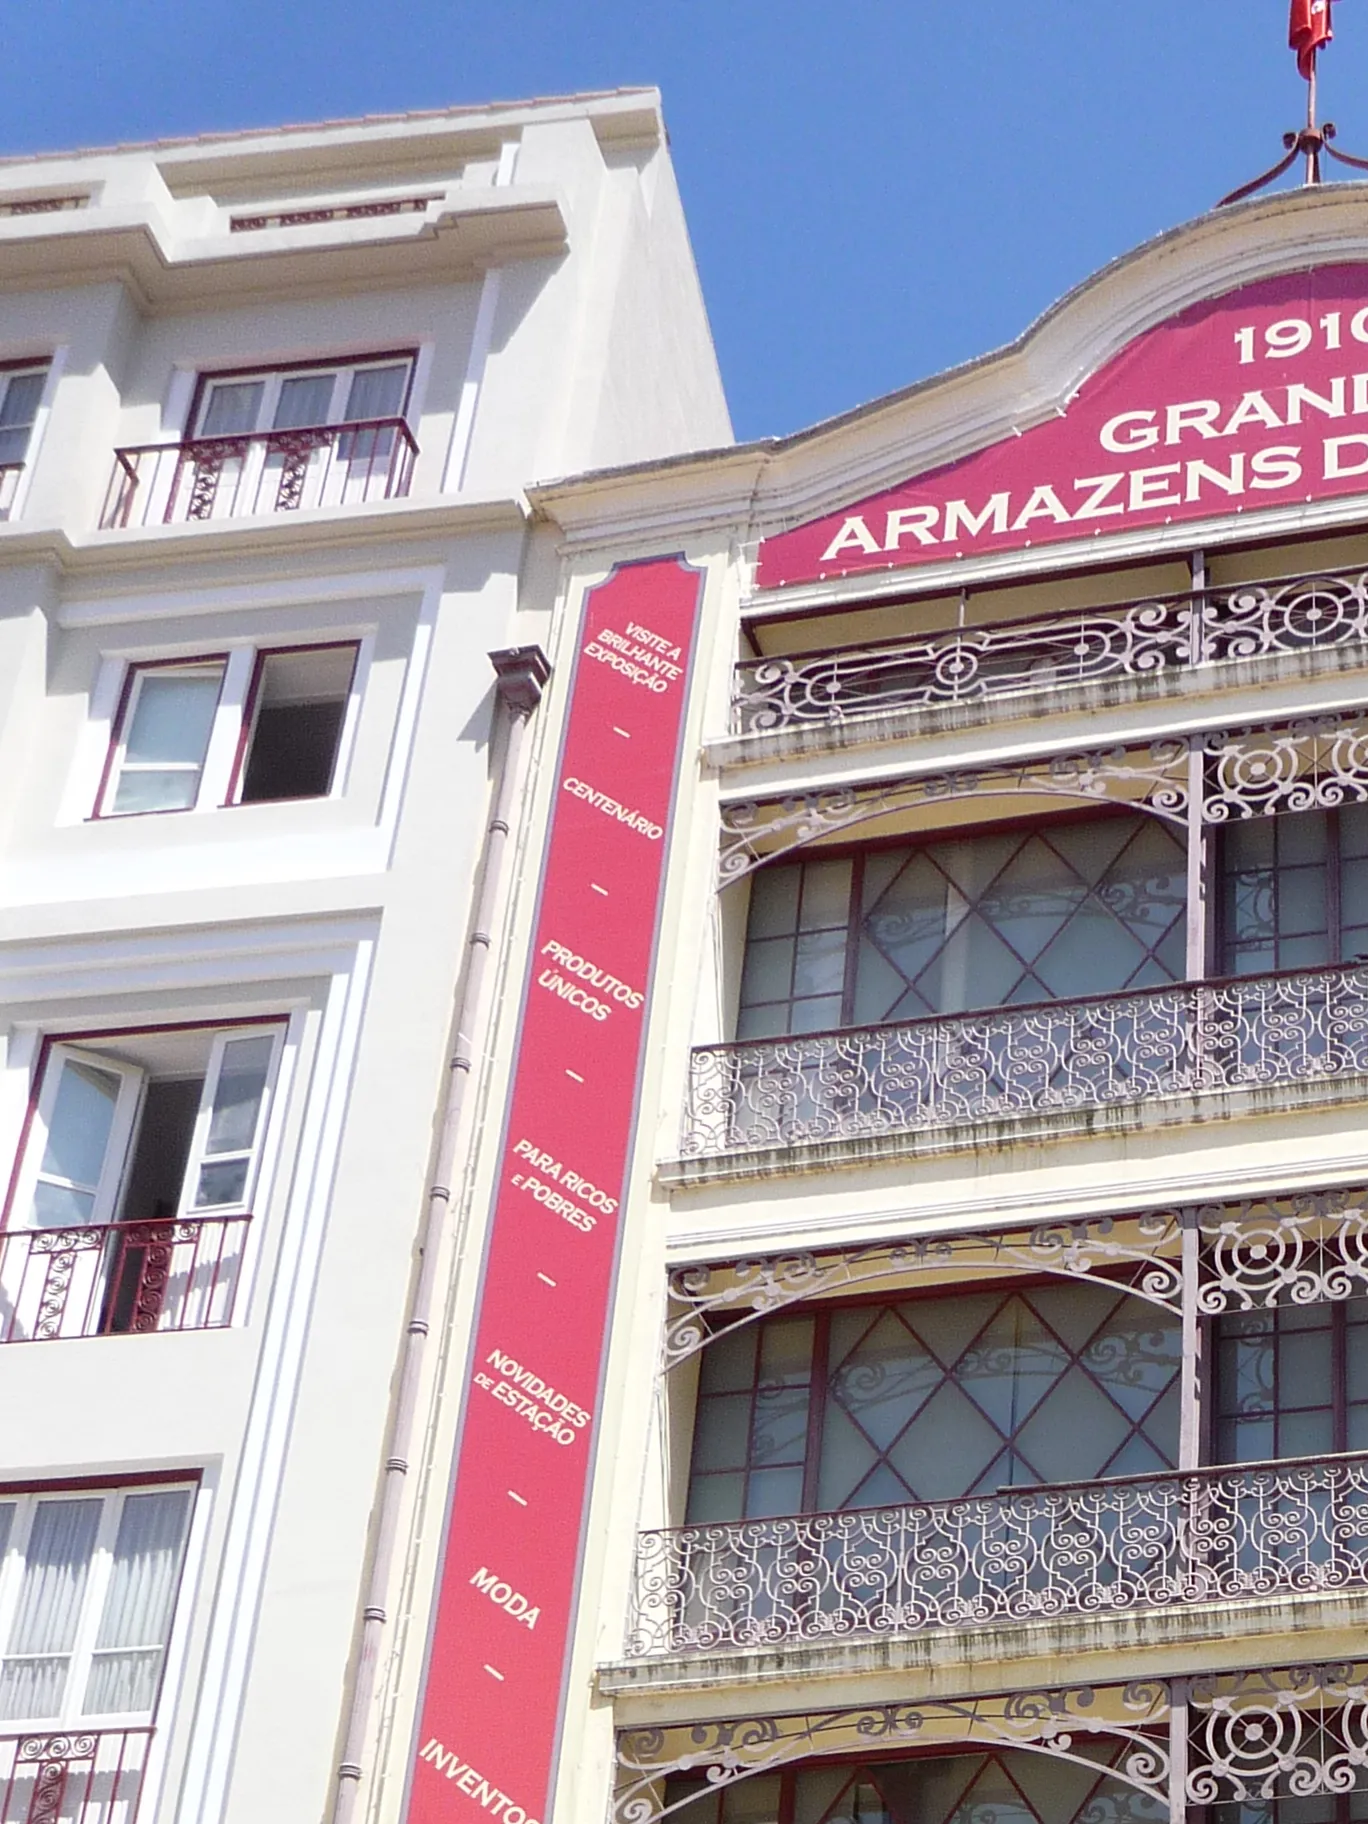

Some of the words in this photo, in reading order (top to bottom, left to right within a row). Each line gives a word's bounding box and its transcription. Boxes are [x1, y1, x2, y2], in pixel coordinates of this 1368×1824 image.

[820, 445, 1302, 561] ARMAZENS
[583, 642, 668, 693] EXPOSIÇÃO
[597, 628, 683, 680] BRILHANTE
[625, 621, 672, 654] VISITE
[666, 647, 682, 661] A
[563, 777, 663, 840] CENTENÁRIO
[537, 968, 612, 1021] ÚNICOS
[541, 939, 643, 1009] PRODUTOS
[510, 1173, 523, 1186] E
[520, 1179, 597, 1232] POBRES
[513, 1139, 562, 1181] PARA
[559, 1170, 618, 1215] RICOS
[473, 1372, 494, 1390] DE
[491, 1385, 575, 1446] ESTAÇÃO
[485, 1349, 591, 1429] NOVIDADES
[469, 1567, 541, 1630] MODA
